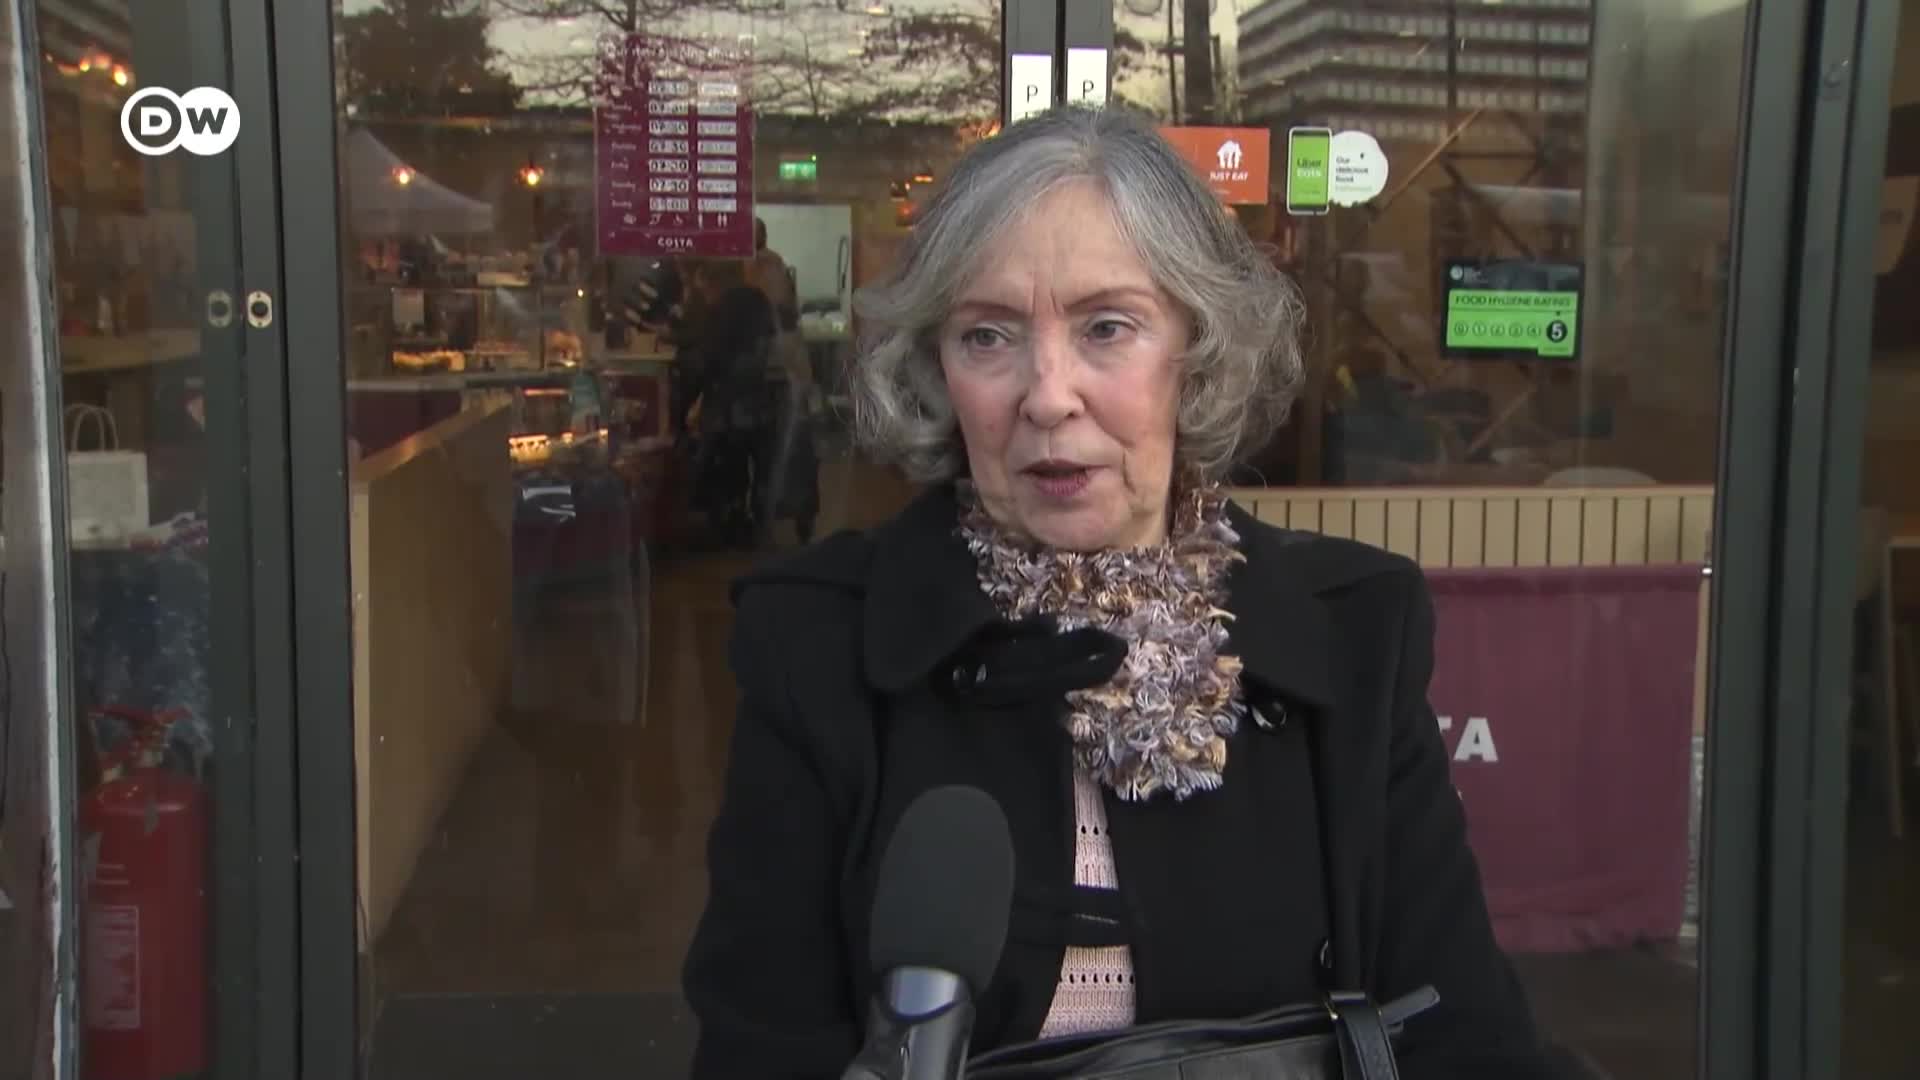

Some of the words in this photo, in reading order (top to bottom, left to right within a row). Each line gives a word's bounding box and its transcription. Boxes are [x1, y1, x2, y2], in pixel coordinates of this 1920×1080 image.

[1210, 171, 1230, 181] JUST
[1231, 171, 1249, 181] EAT
[657, 237, 694, 248] COSTA
[1456, 295, 1487, 305] FOOD
[1551, 322, 1564, 340] 5
